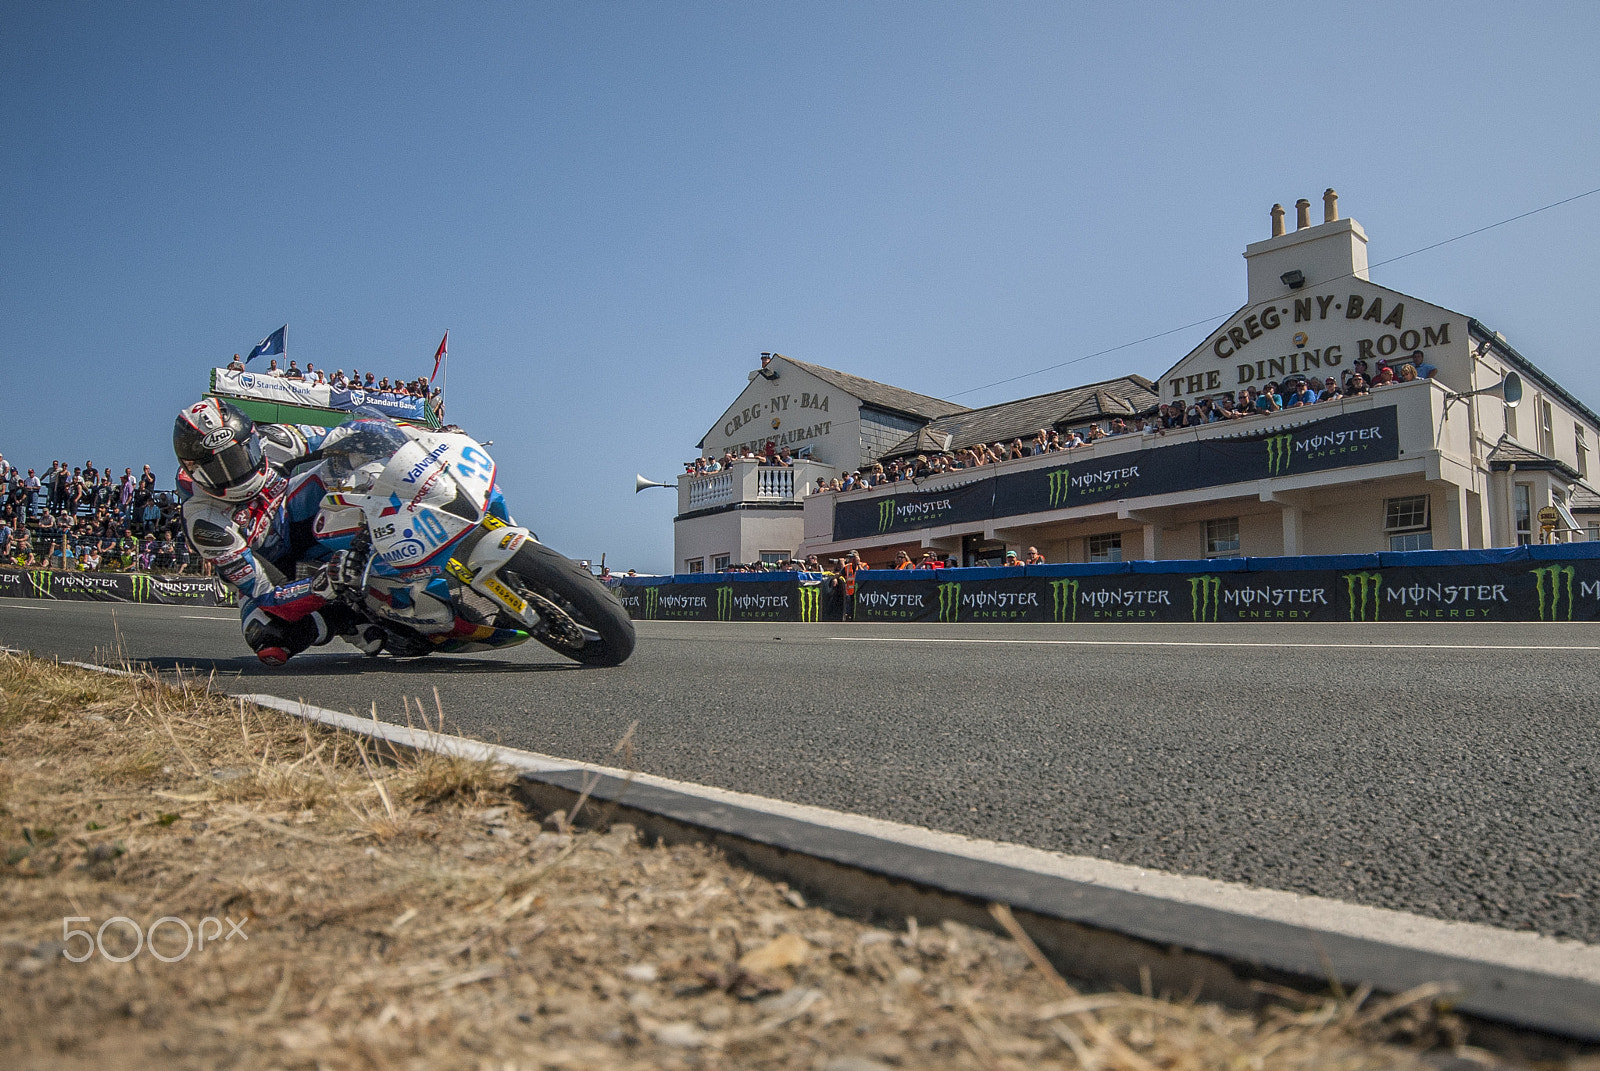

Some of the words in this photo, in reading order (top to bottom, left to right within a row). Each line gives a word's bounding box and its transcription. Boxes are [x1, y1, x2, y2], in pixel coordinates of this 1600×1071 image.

[1169, 369, 1221, 398] THE
[1236, 345, 1342, 385] DINING
[1356, 322, 1451, 361] ROOM
[366, 396, 398, 410] Standard
[399, 399, 417, 410] Bank
[207, 429, 230, 444] Arai
[1296, 426, 1384, 452] MONSTER
[1307, 444, 1369, 459] ENERGY
[1071, 465, 1140, 488] MONSTER
[1080, 482, 1129, 495] ENERGY
[896, 499, 952, 517] MONSTER
[411, 508, 449, 548] 10
[54, 576, 119, 589] MONSTER
[152, 581, 215, 593] MONSTER
[621, 596, 640, 607] STER
[659, 594, 707, 609] MONSTER
[733, 593, 789, 610] MONSTER
[859, 590, 925, 608] MONSTER
[962, 590, 1039, 609] MONSTER
[1081, 588, 1171, 608] MONSTER
[1223, 585, 1328, 608] MONSTER
[1386, 583, 1509, 606] MONSTER
[867, 609, 914, 617] ENERGY
[973, 610, 1027, 618] ENERGY
[1094, 610, 1157, 618] ENERGY
[1238, 610, 1312, 619] ENERGY
[1405, 608, 1492, 618] ENERGY
